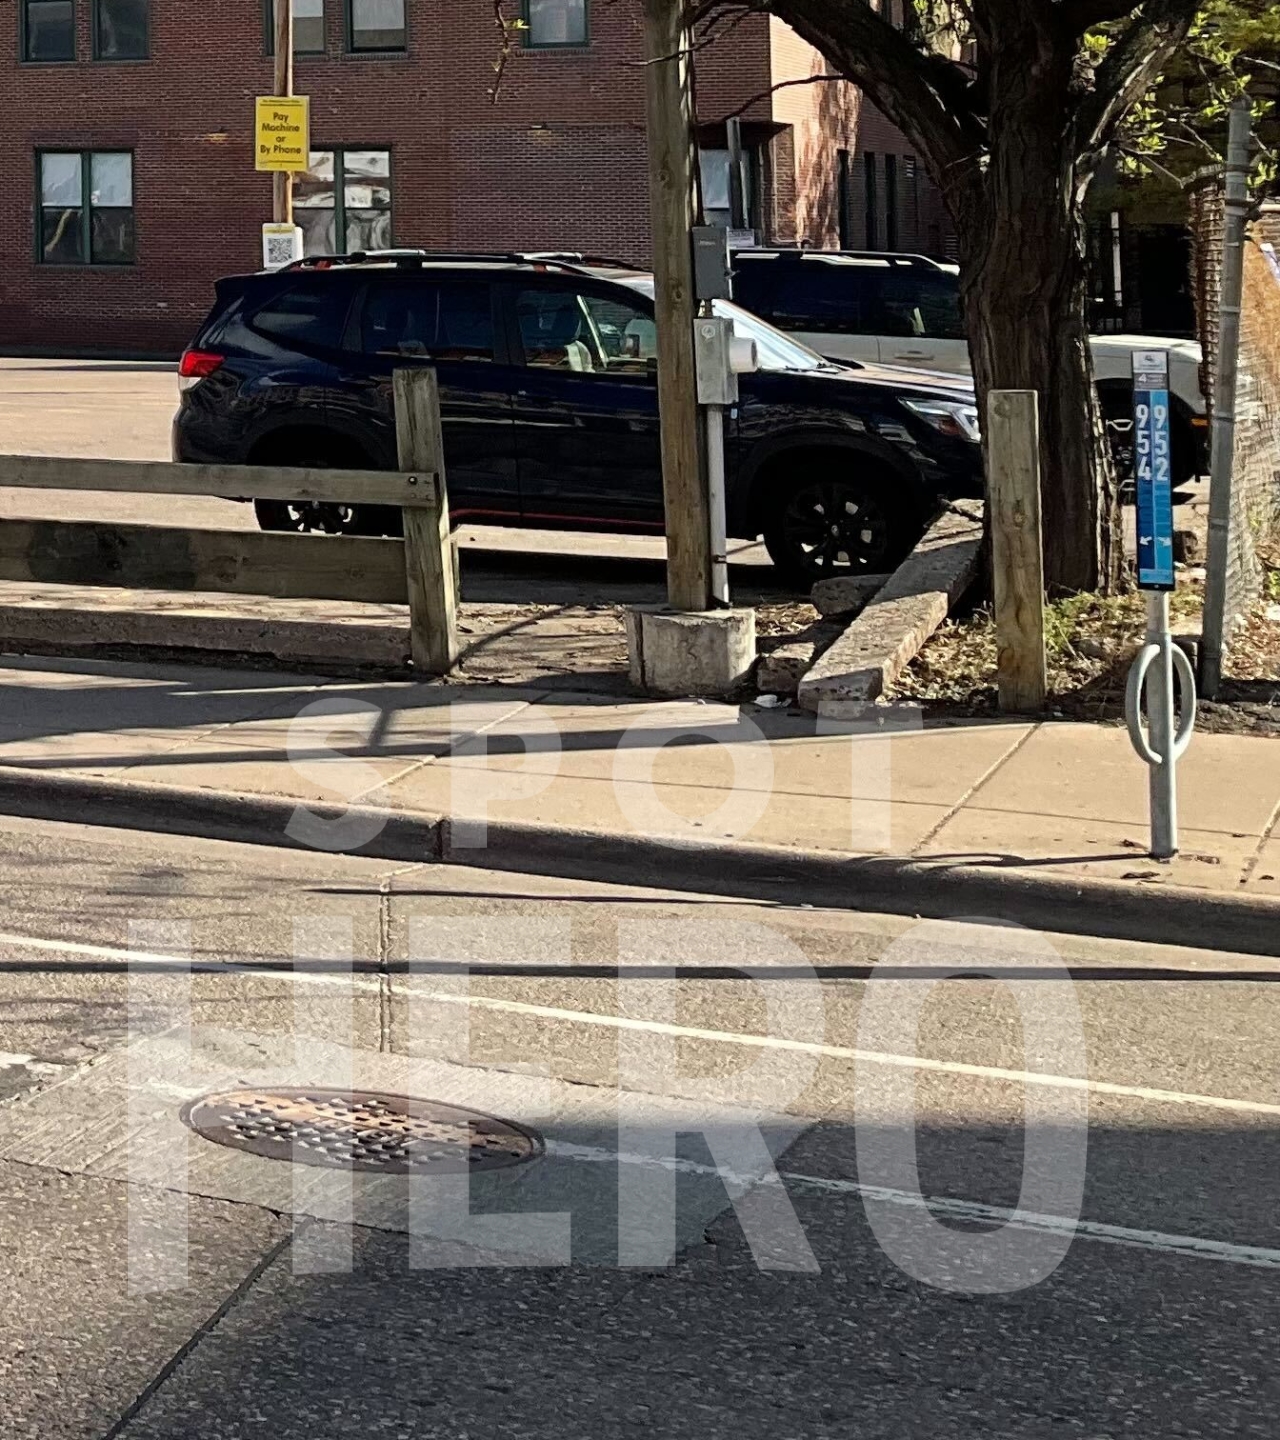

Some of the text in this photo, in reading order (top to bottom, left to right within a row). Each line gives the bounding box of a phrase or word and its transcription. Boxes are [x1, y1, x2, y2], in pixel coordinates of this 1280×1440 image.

[272, 112, 289, 125] Pay
[261, 122, 300, 133] Machine
[275, 135, 286, 143] or
[260, 144, 302, 155] By Phone
